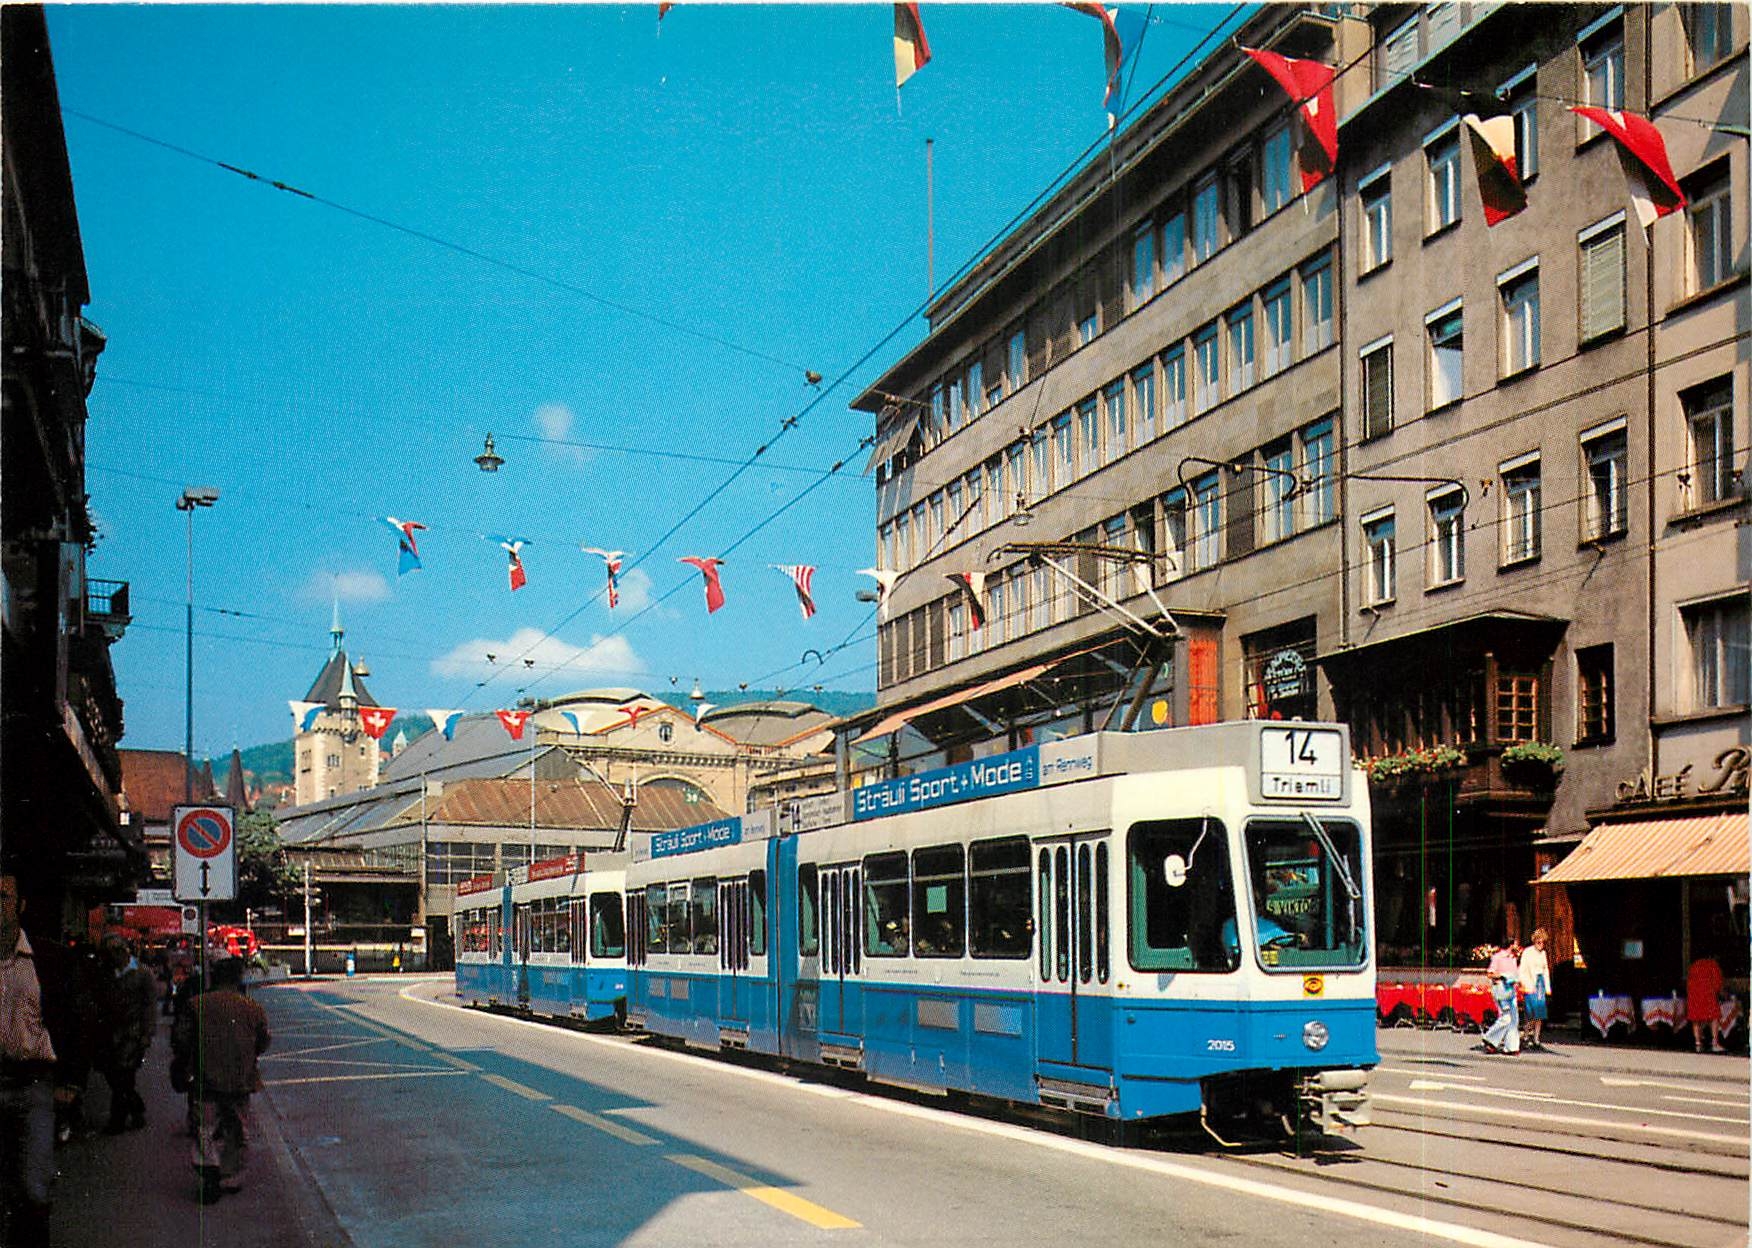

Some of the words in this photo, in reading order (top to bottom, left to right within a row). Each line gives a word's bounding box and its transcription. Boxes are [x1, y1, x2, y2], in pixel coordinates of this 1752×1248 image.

[1285, 730, 1318, 765] 14
[857, 781, 905, 812] Sträuli
[910, 771, 960, 808] Sport
[970, 758, 1022, 789] Mode
[1273, 777, 1331, 793] Triemli
[1207, 1039, 1236, 1051] 2015
